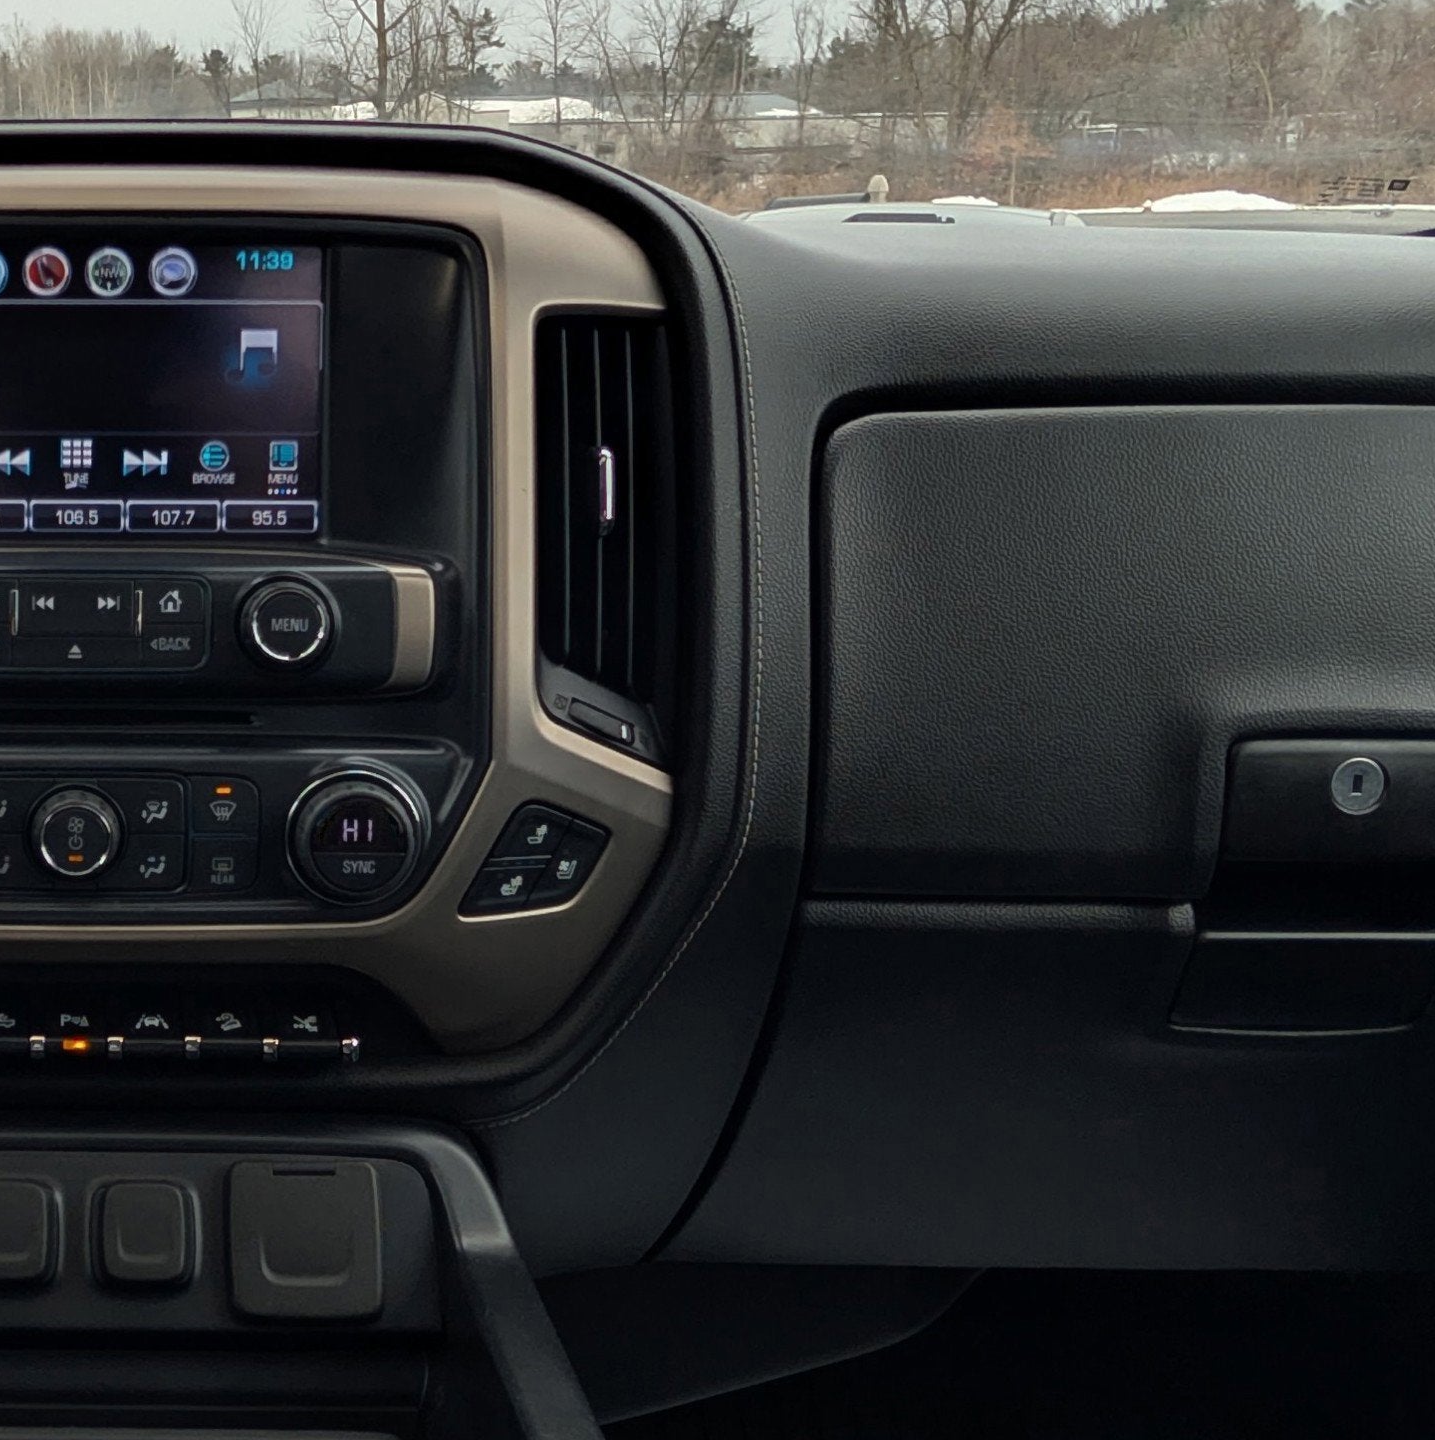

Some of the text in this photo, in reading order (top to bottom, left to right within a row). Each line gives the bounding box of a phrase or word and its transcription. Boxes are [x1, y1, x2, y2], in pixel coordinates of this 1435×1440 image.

[236, 250, 294, 271] 11:39
[192, 472, 235, 484] BROWSE
[267, 472, 299, 484] MENU
[55, 509, 99, 526] 106.5
[151, 509, 196, 526] 107.7
[252, 509, 288, 526] 95.5
[270, 617, 309, 633] MENU
[159, 637, 192, 652] BACK
[342, 819, 374, 842] HI
[342, 860, 376, 874] SYNC
[210, 874, 235, 884] REAR
